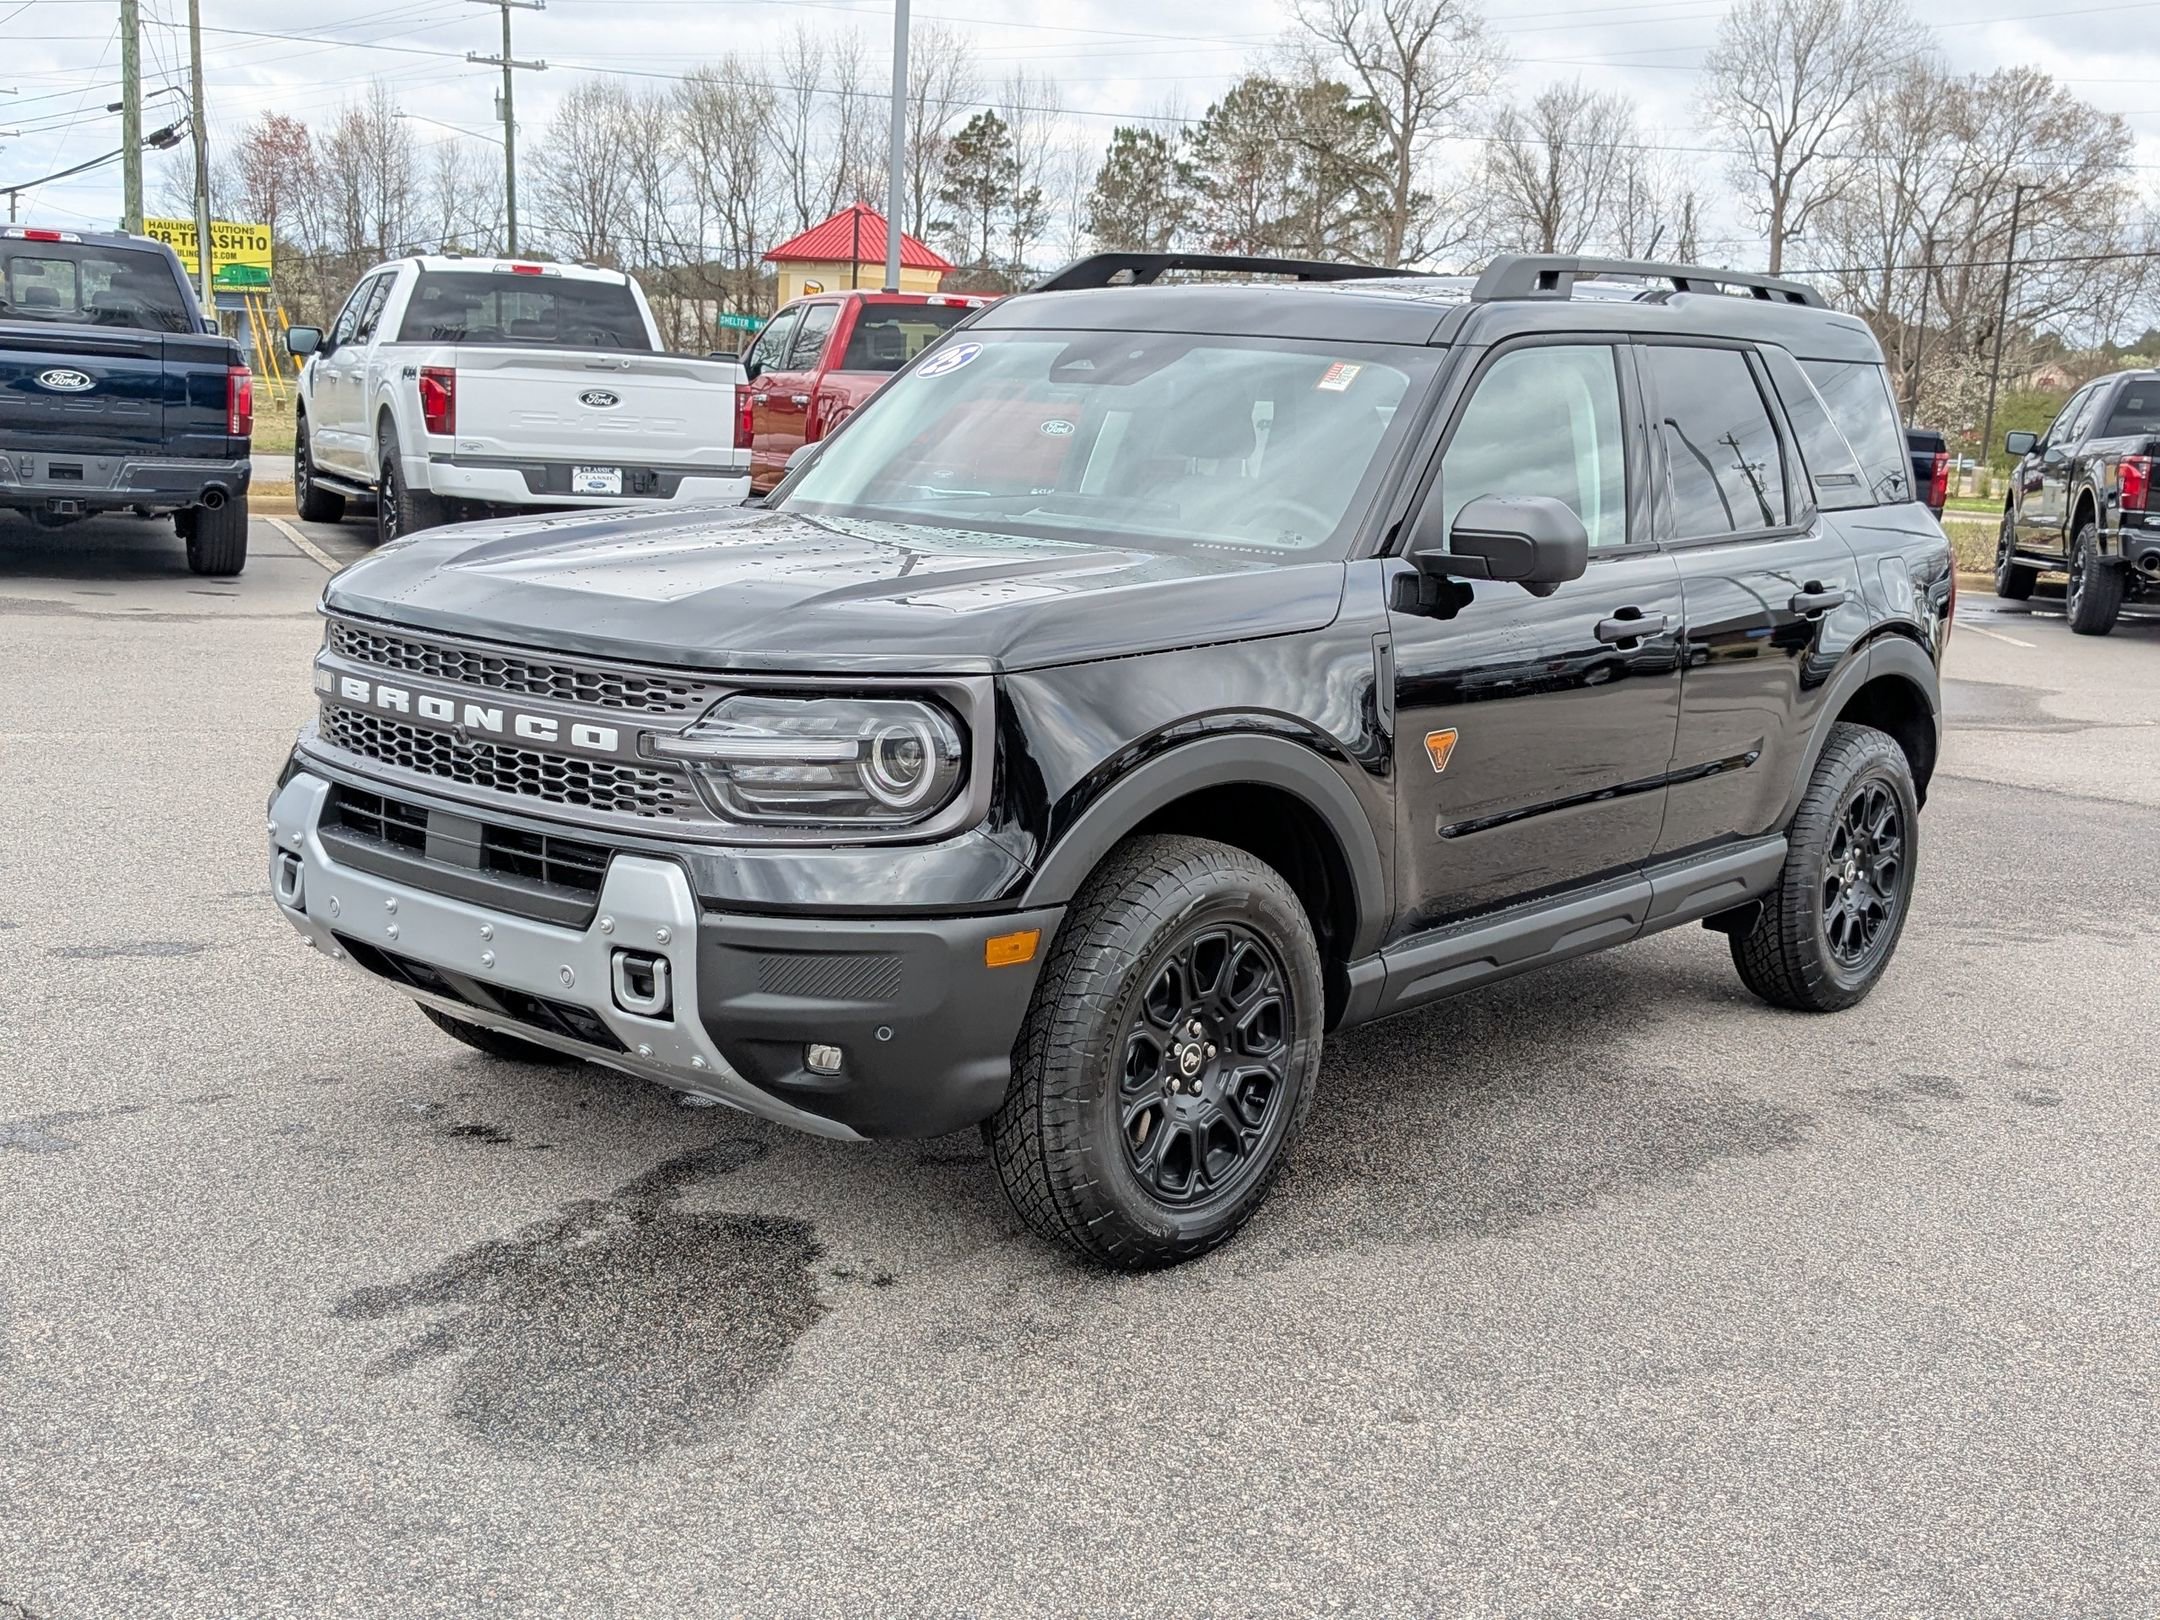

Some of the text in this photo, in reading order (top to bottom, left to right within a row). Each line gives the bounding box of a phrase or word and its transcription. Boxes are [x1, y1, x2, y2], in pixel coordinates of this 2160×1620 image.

[148, 221, 195, 232] HAULING
[720, 316, 749, 327] SHELTER
[46, 371, 84, 387] Ford
[584, 392, 615, 406] Ford
[1044, 421, 1071, 434] Ford
[341, 676, 618, 751] BRONCO
